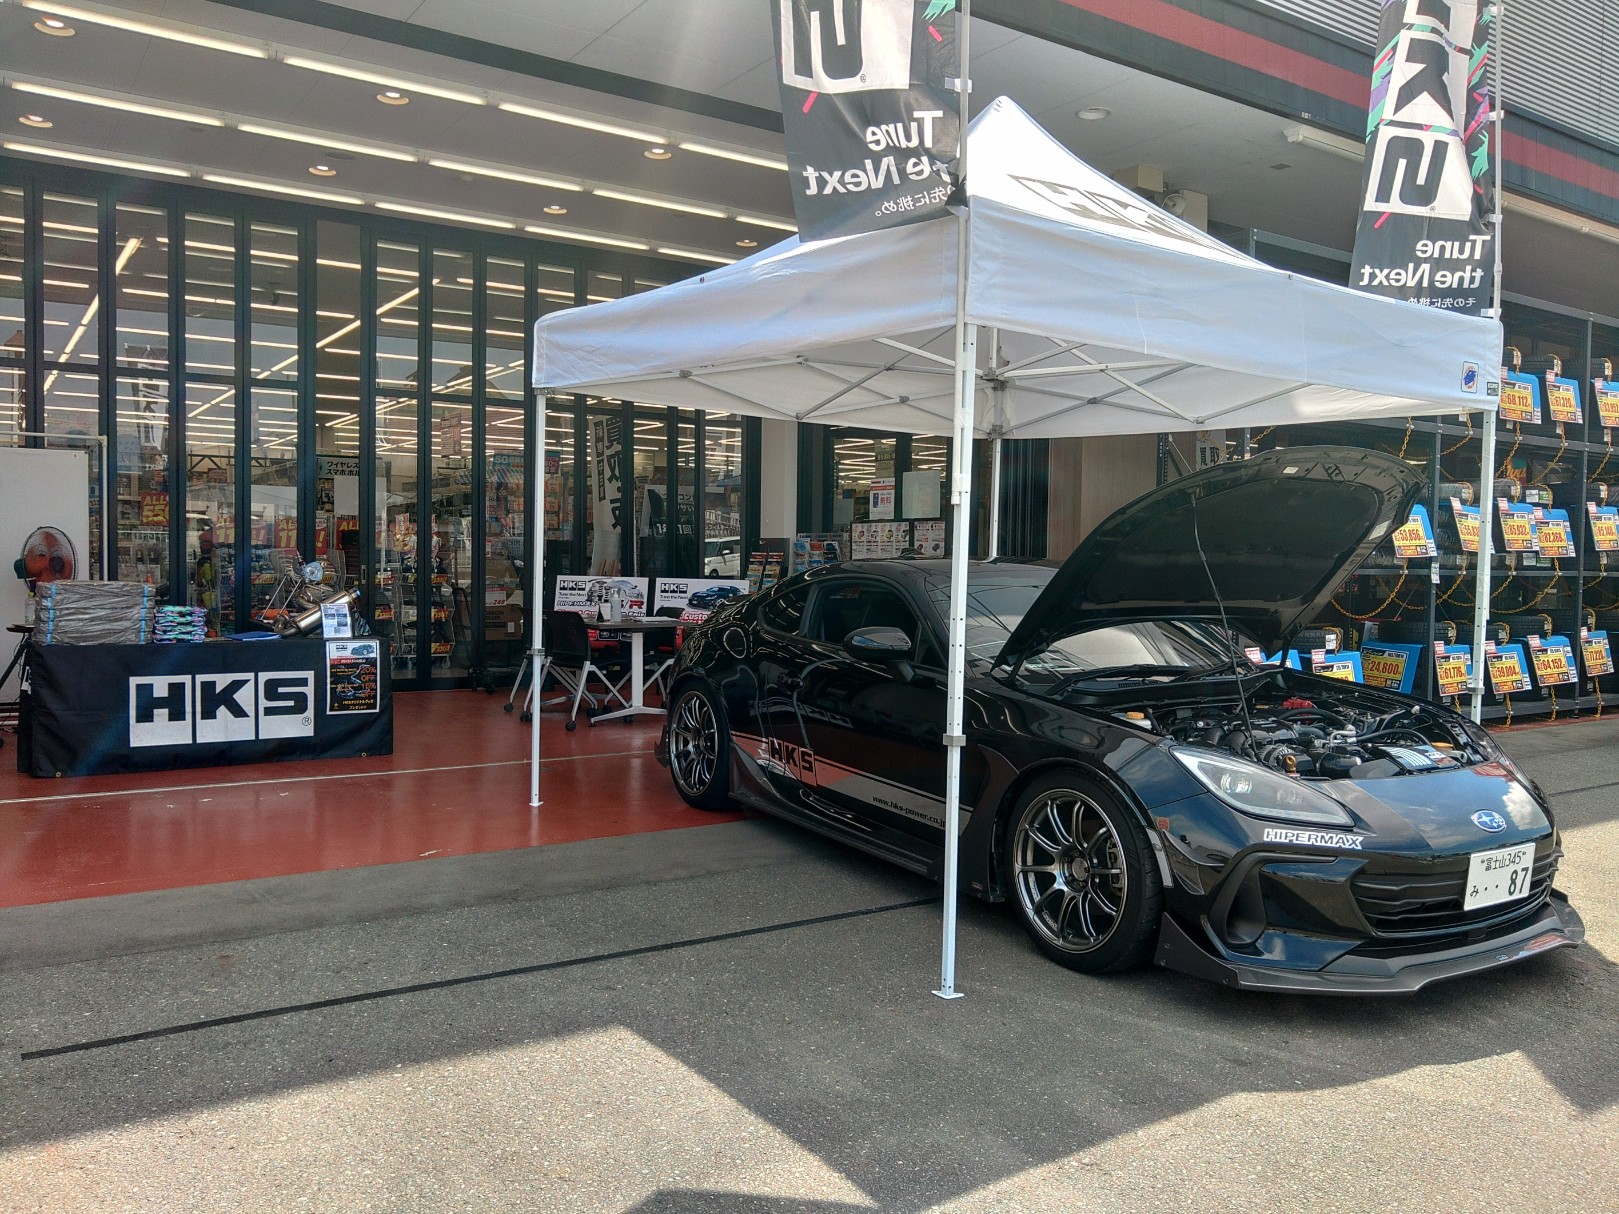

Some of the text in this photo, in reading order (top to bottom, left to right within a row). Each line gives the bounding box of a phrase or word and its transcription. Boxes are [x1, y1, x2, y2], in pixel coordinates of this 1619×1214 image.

[560, 580, 586, 591] HKS
[661, 583, 688, 594] HKS
[1370, 660, 1399, 675] 24,800
[132, 672, 312, 735] HKS
[768, 738, 815, 778] HKS
[1264, 828, 1364, 849] HIPERMAX
[1508, 866, 1530, 896] 87
